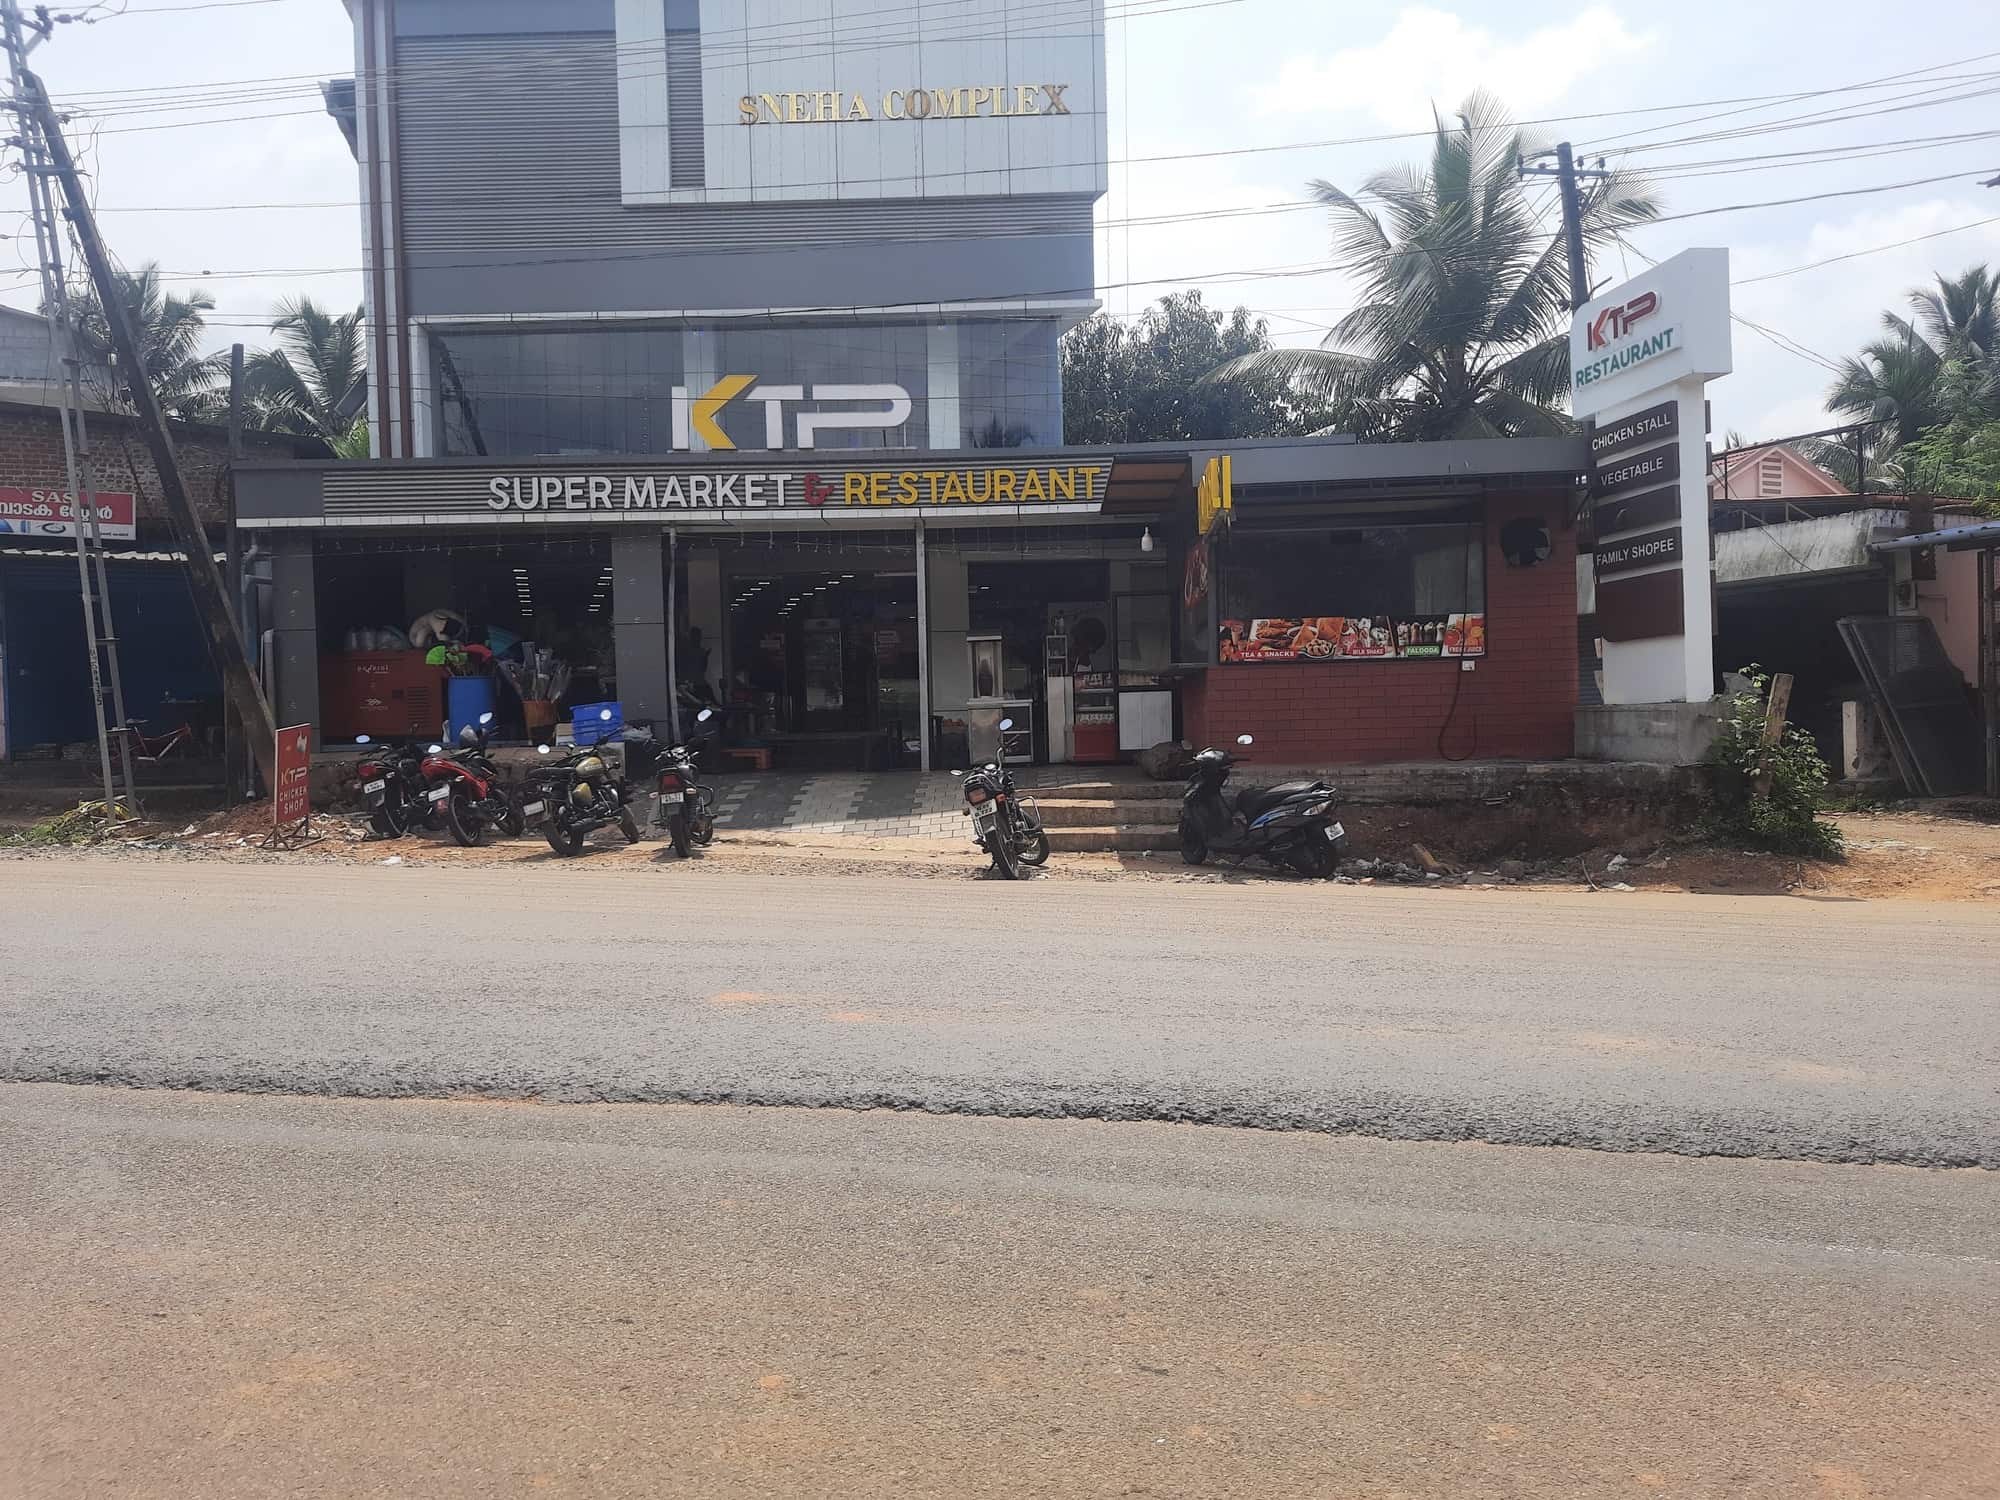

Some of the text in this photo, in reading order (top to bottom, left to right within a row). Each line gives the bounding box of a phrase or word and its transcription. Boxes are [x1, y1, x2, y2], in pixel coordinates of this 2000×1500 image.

[738, 84, 1071, 124] SNEHA COMPLEX
[1587, 291, 1657, 352] KTP
[1575, 328, 1674, 389] RESTAURANT
[671, 374, 912, 450] KTP
[1592, 414, 1671, 451] CHICKEN STALL
[487, 466, 1101, 511] SUPER MARKET & RESTAURANT
[1600, 457, 1663, 487] VEGETABLE
[1596, 538, 1674, 566] FAMILY SHOPEE
[280, 785, 307, 802] CHICKEN
[281, 766, 307, 785] KTP
[284, 798, 304, 815] SHOP
